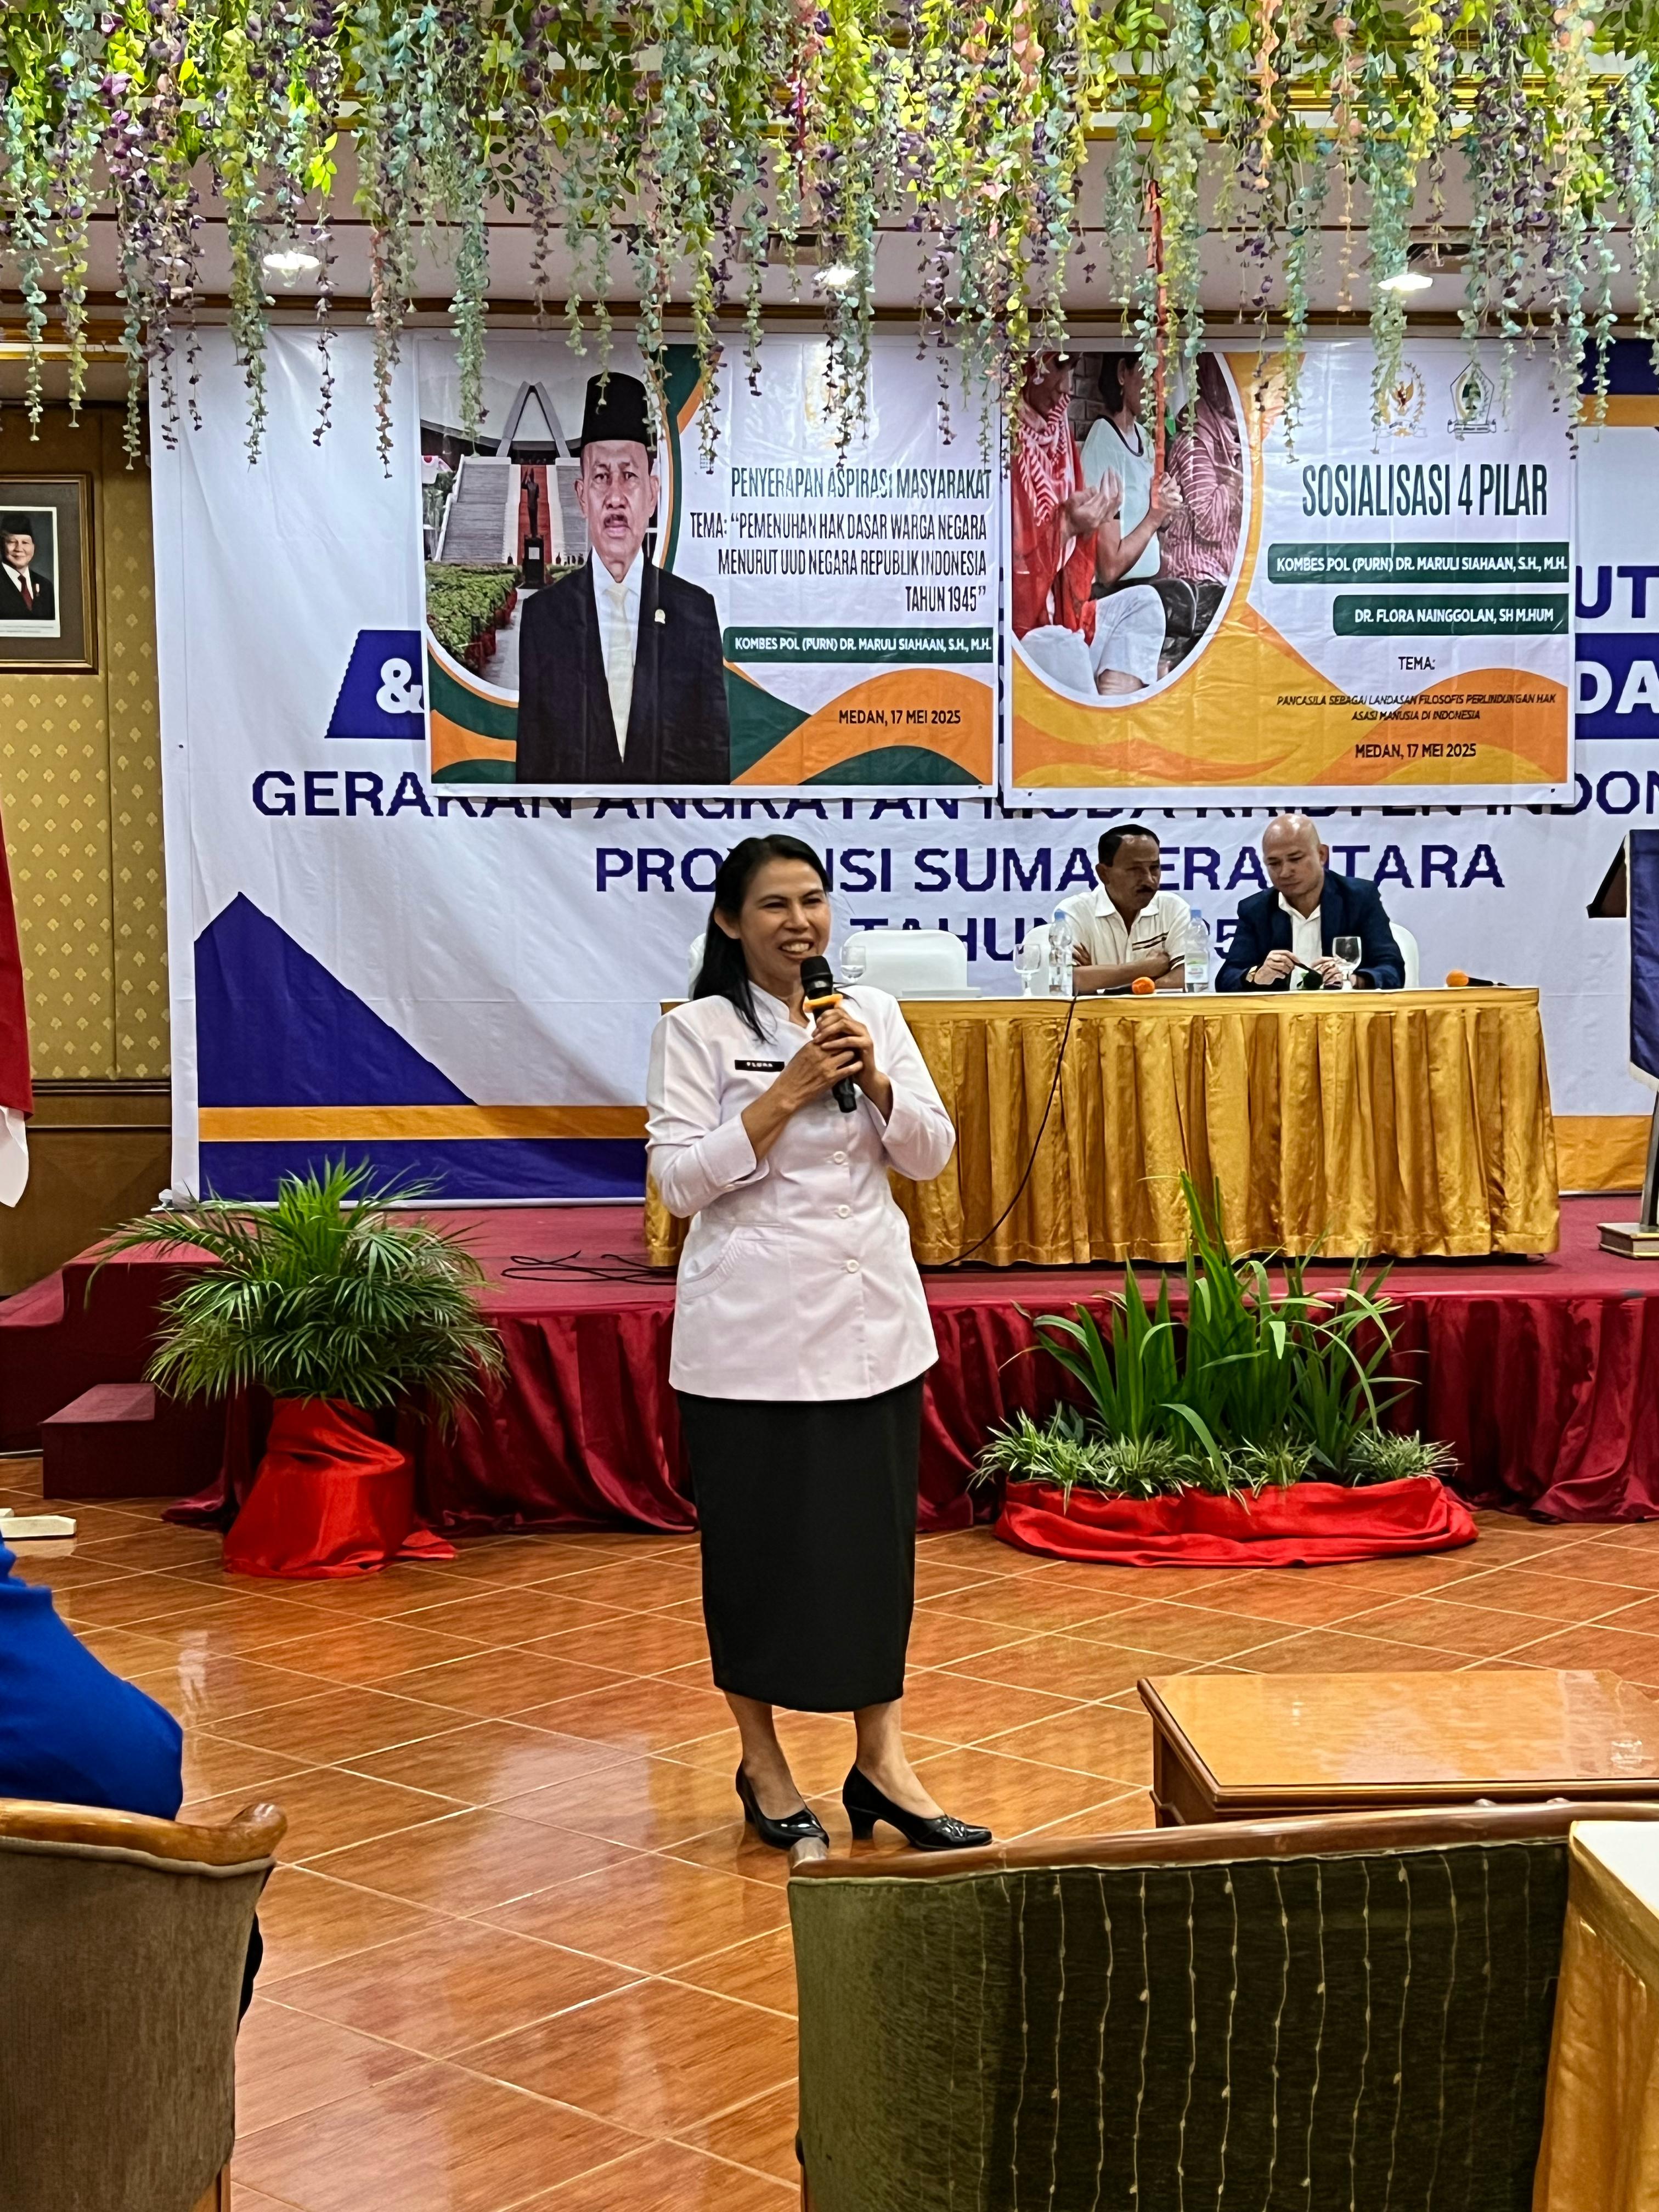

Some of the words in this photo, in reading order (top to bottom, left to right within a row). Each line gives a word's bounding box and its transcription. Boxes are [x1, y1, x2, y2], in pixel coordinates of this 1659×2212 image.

[732, 467, 823, 497] PENYERAPAN
[828, 468, 893, 498] ASPIRASI
[896, 469, 992, 499] MASYARAKAT
[1302, 464, 1450, 516] SOSIALISASI
[1458, 464, 1473, 516] 4
[1479, 464, 1548, 516] PILAR
[690, 512, 727, 538] TEMA:
[820, 513, 844, 539] HAK
[848, 514, 887, 539] DASAR
[891, 514, 935, 540] WARGA
[938, 514, 987, 540] NEGARA
[718, 549, 778, 574] MENURUT
[781, 549, 805, 575] UUD
[809, 549, 857, 575] NEGARA
[861, 550, 919, 575] REPUBLIK
[922, 550, 986, 575] INDONESIA
[1277, 557, 1325, 571] KOMBES
[1325, 557, 1351, 571] POL
[1352, 557, 1393, 573] (PURN)
[1396, 557, 1415, 571] DR.
[1417, 556, 1460, 571] MARULI
[1462, 556, 1516, 572] SIAHAAN,
[1544, 556, 1568, 570] M.H.
[905, 585, 945, 612] TAHUN
[1355, 608, 1374, 623] DR.
[1376, 608, 1415, 623] FLORA
[1417, 608, 1497, 624] NAINGGOLAN,
[1499, 608, 1514, 622] SH
[1516, 608, 1554, 622] M.HUM
[735, 637, 778, 650] KOMBES
[780, 637, 800, 650] POL
[802, 637, 838, 652] (PURN)
[840, 637, 857, 650] DR.
[859, 637, 896, 651] MARULI
[899, 637, 946, 653] SIAHAAN,
[948, 638, 969, 653] S.H.,
[970, 638, 992, 651] M.H.
[1398, 656, 1436, 670] TEMA:
[1277, 695, 1327, 706] PANCASILA
[1329, 695, 1368, 706] SEBAGAI
[1369, 695, 1417, 706] LANDASAN
[1418, 694, 1464, 705] FILOSOFIS
[1465, 693, 1535, 704] PERLINDUNGAN
[1536, 693, 1557, 704] HAK
[839, 709, 888, 727] MEDAN,
[890, 709, 903, 724] 17
[906, 709, 928, 724] MEI
[931, 710, 961, 724] 2025
[1351, 711, 1379, 721] ASASI
[1379, 710, 1419, 721] MANUSIA
[1421, 710, 1431, 720] DI
[1432, 710, 1481, 720] INDONESIA
[1355, 743, 1404, 760] MEDAN,
[1407, 743, 1419, 758] 17
[1421, 743, 1444, 758] MEI
[1446, 743, 1477, 758] 2025
[596, 848, 891, 892] PROSI
[914, 847, 1268, 892] SUMAERA
[1325, 844, 1505, 888] TARA
